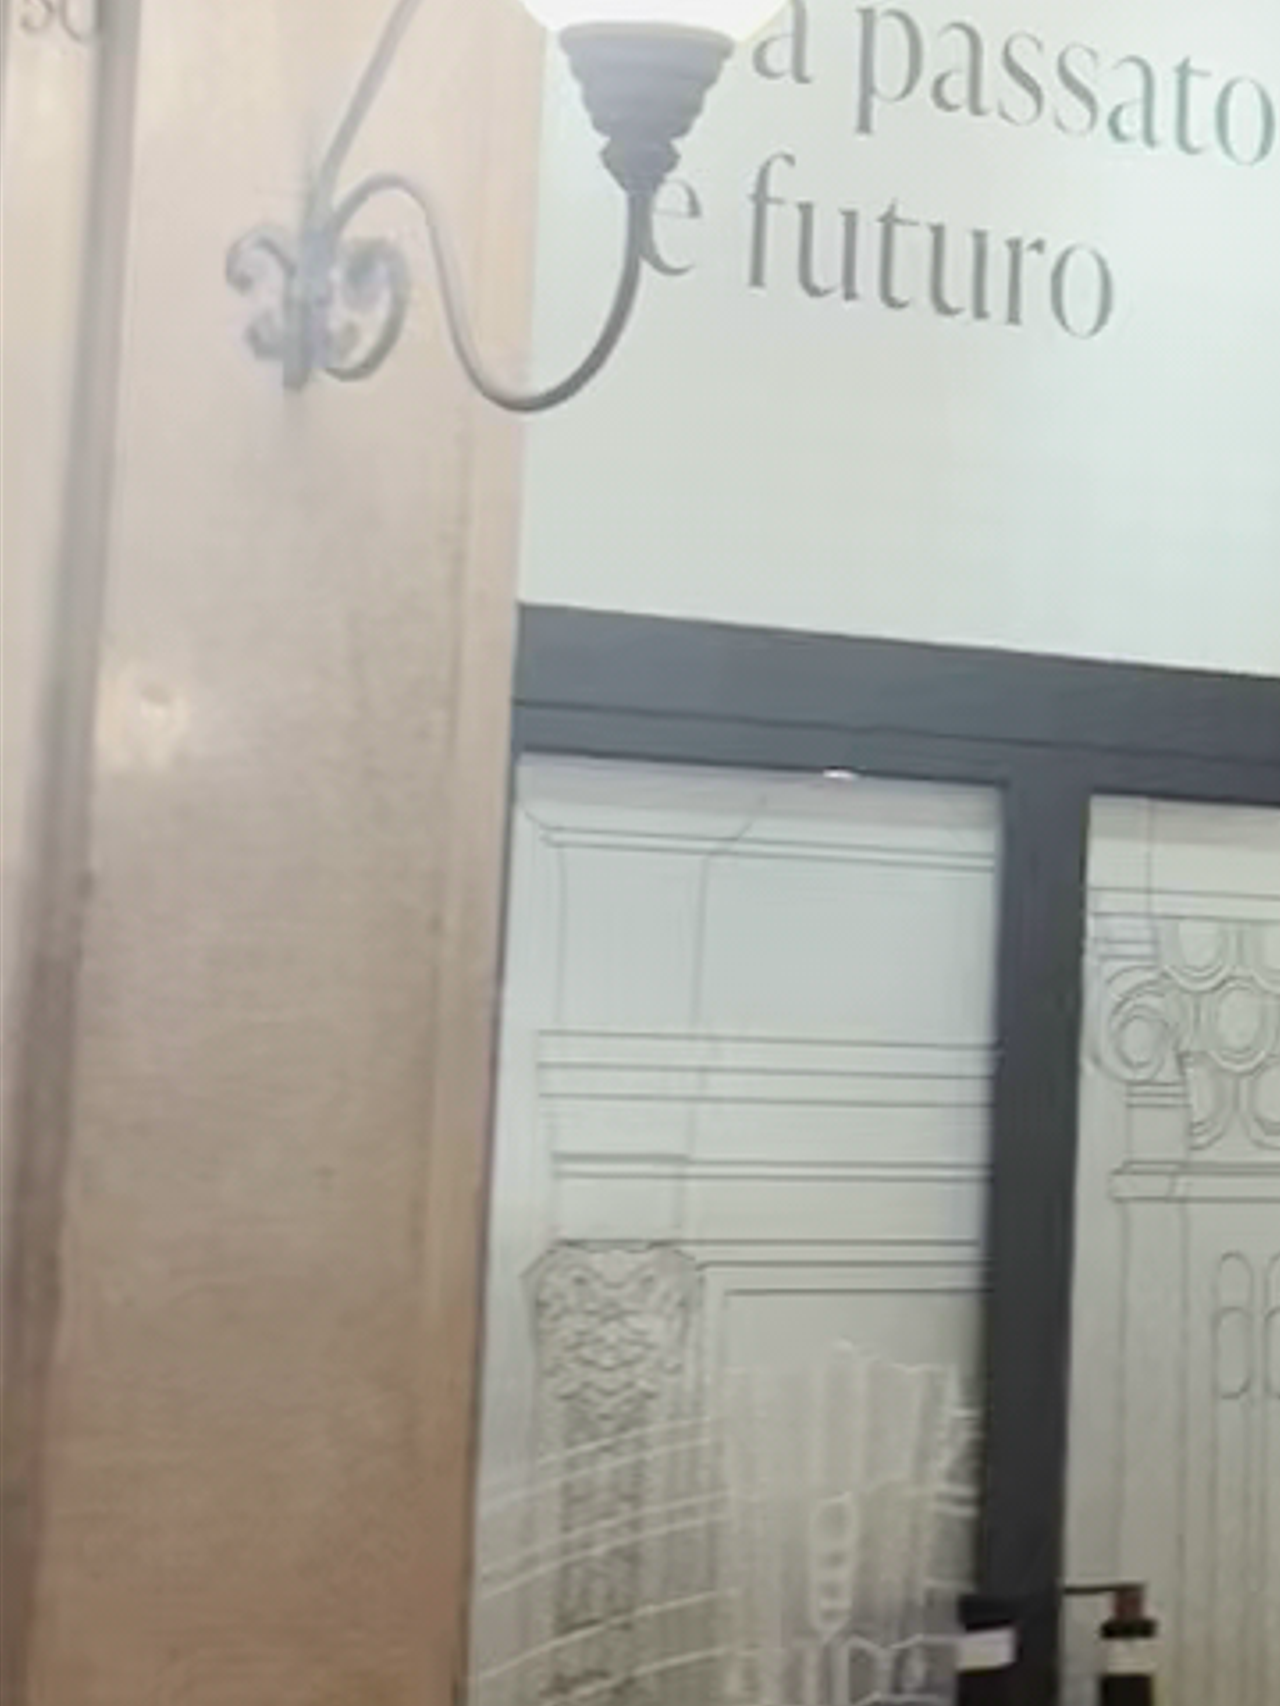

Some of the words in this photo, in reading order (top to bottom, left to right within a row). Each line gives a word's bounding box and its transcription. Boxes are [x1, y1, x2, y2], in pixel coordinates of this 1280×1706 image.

[855, 2, 1276, 166] passato
[637, 172, 701, 277] e
[746, 152, 1116, 339] futuro
